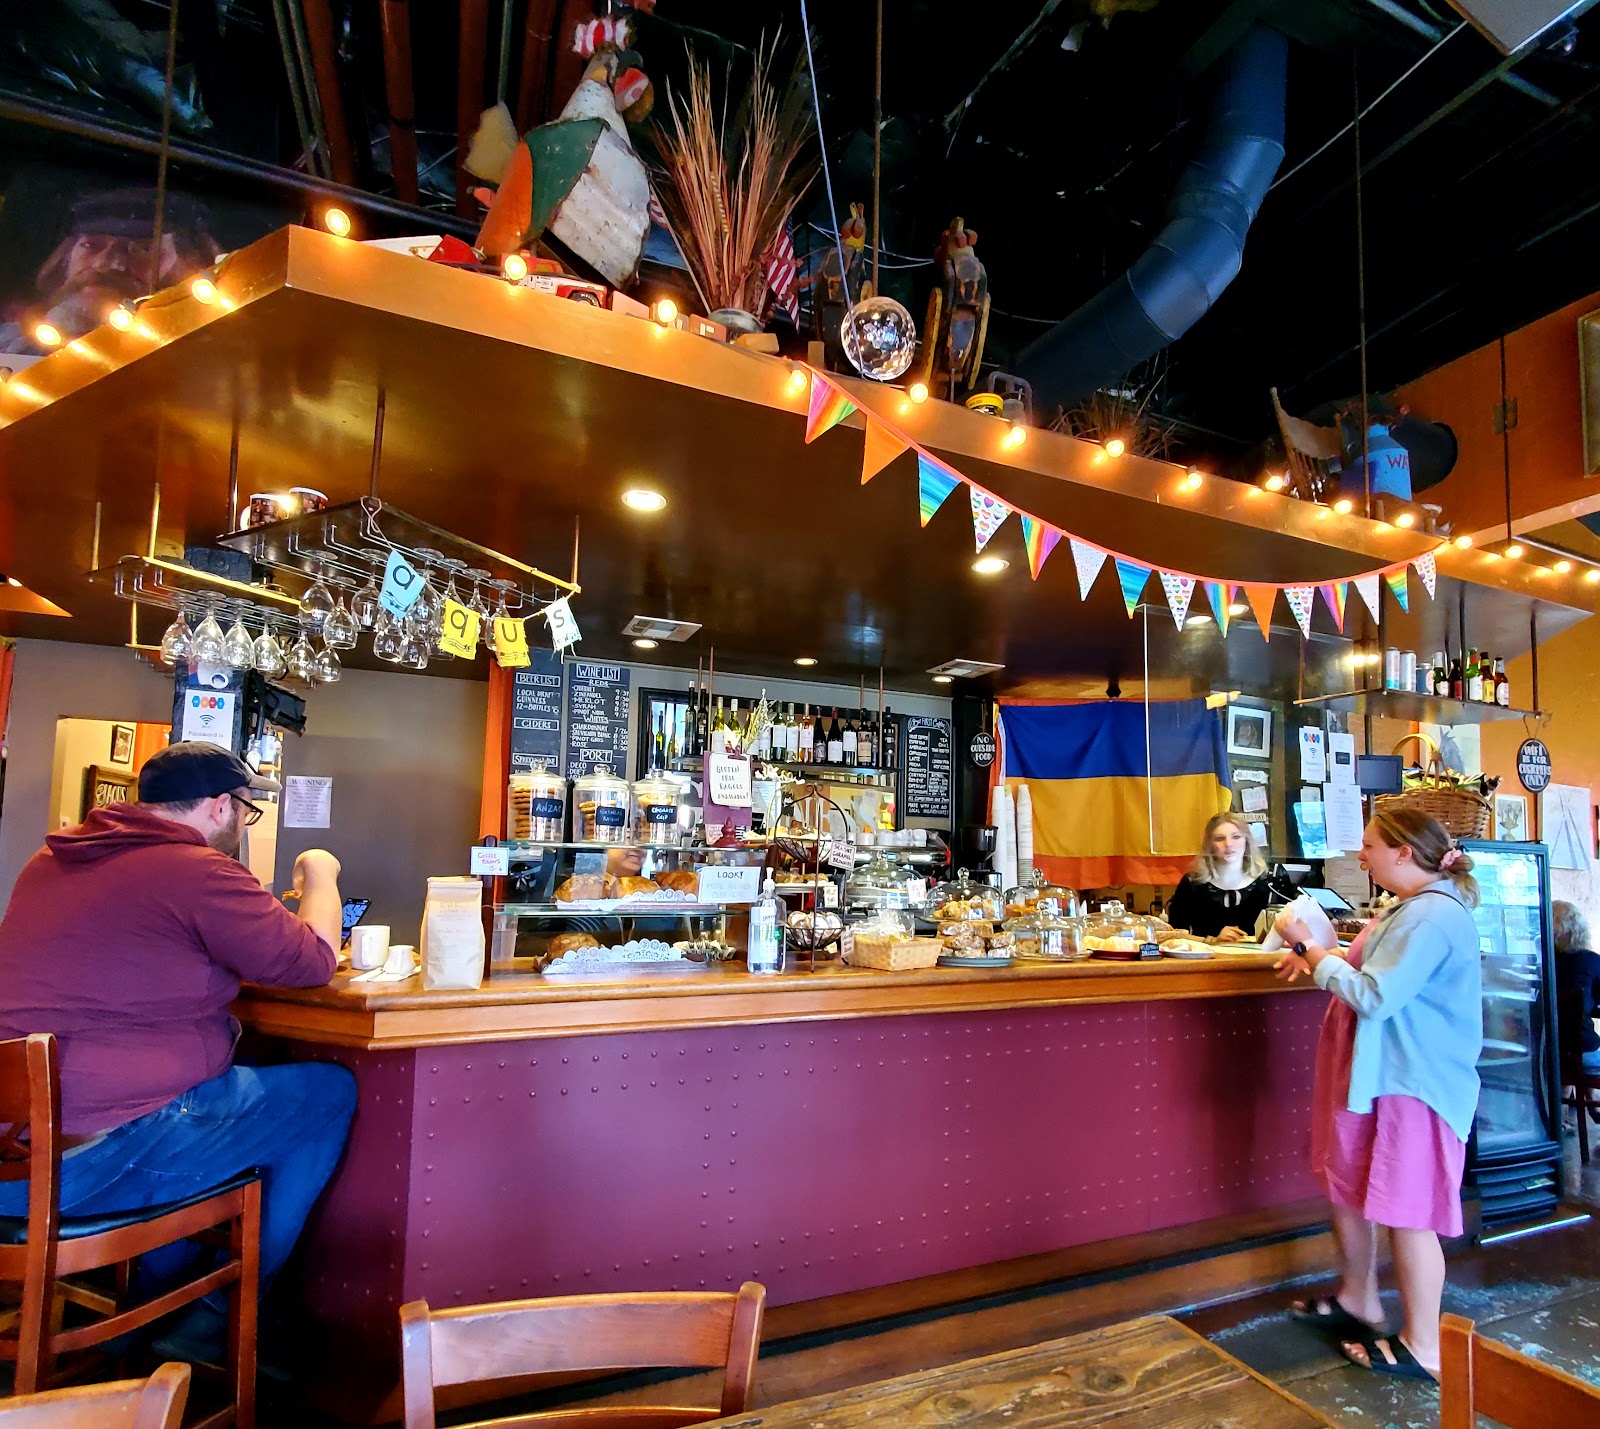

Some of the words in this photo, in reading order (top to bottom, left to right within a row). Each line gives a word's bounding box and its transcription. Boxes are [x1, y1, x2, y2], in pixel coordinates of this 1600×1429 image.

[578, 665, 600, 678] WINE
[602, 668, 620, 680] LIST
[519, 674, 540, 684] BEER
[588, 679, 609, 687] REDS
[517, 688, 536, 697] LOCAL
[516, 696, 546, 704] GUINNESS
[574, 698, 606, 706] MERLOT
[583, 715, 609, 723] WHITES
[521, 719, 552, 729] CIDERS
[582, 750, 610, 762] PORT
[1525, 774, 1546, 786] ONLY
[535, 802, 562, 813] ANZAC
[717, 871, 744, 879] LOOK!
